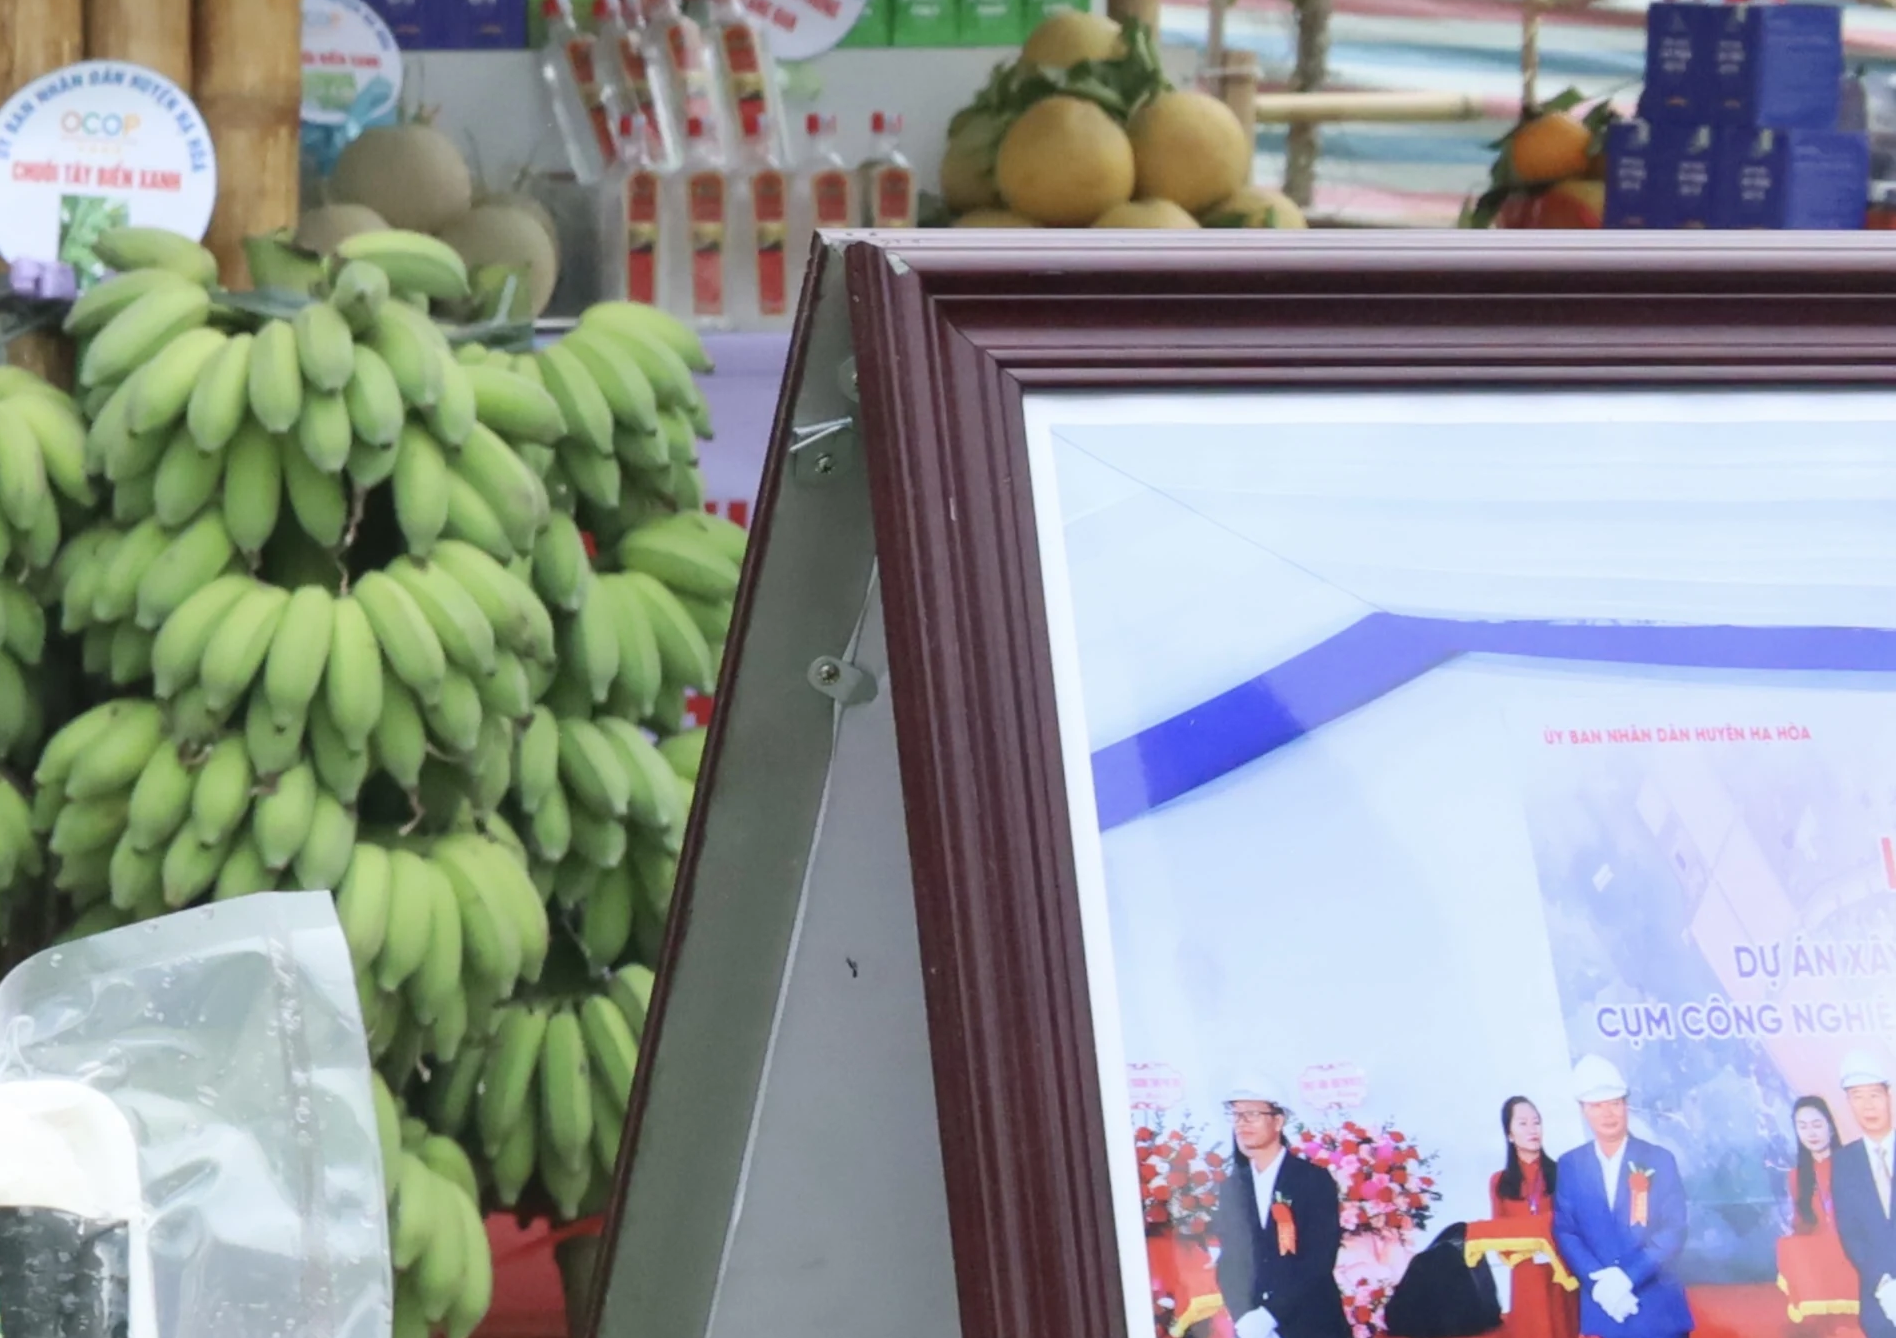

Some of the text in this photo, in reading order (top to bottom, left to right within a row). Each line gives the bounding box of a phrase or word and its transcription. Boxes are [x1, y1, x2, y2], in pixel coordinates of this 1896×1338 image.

[1544, 722, 1812, 746] ỦY BAN NHÂN DÂN HUYỆN HẠ HÒA
[1733, 941, 1782, 990] DỰ
[1792, 935, 1837, 978] ÁN
[1596, 1005, 1673, 1048] CỤM
[1681, 995, 1784, 1038] CÔNG
